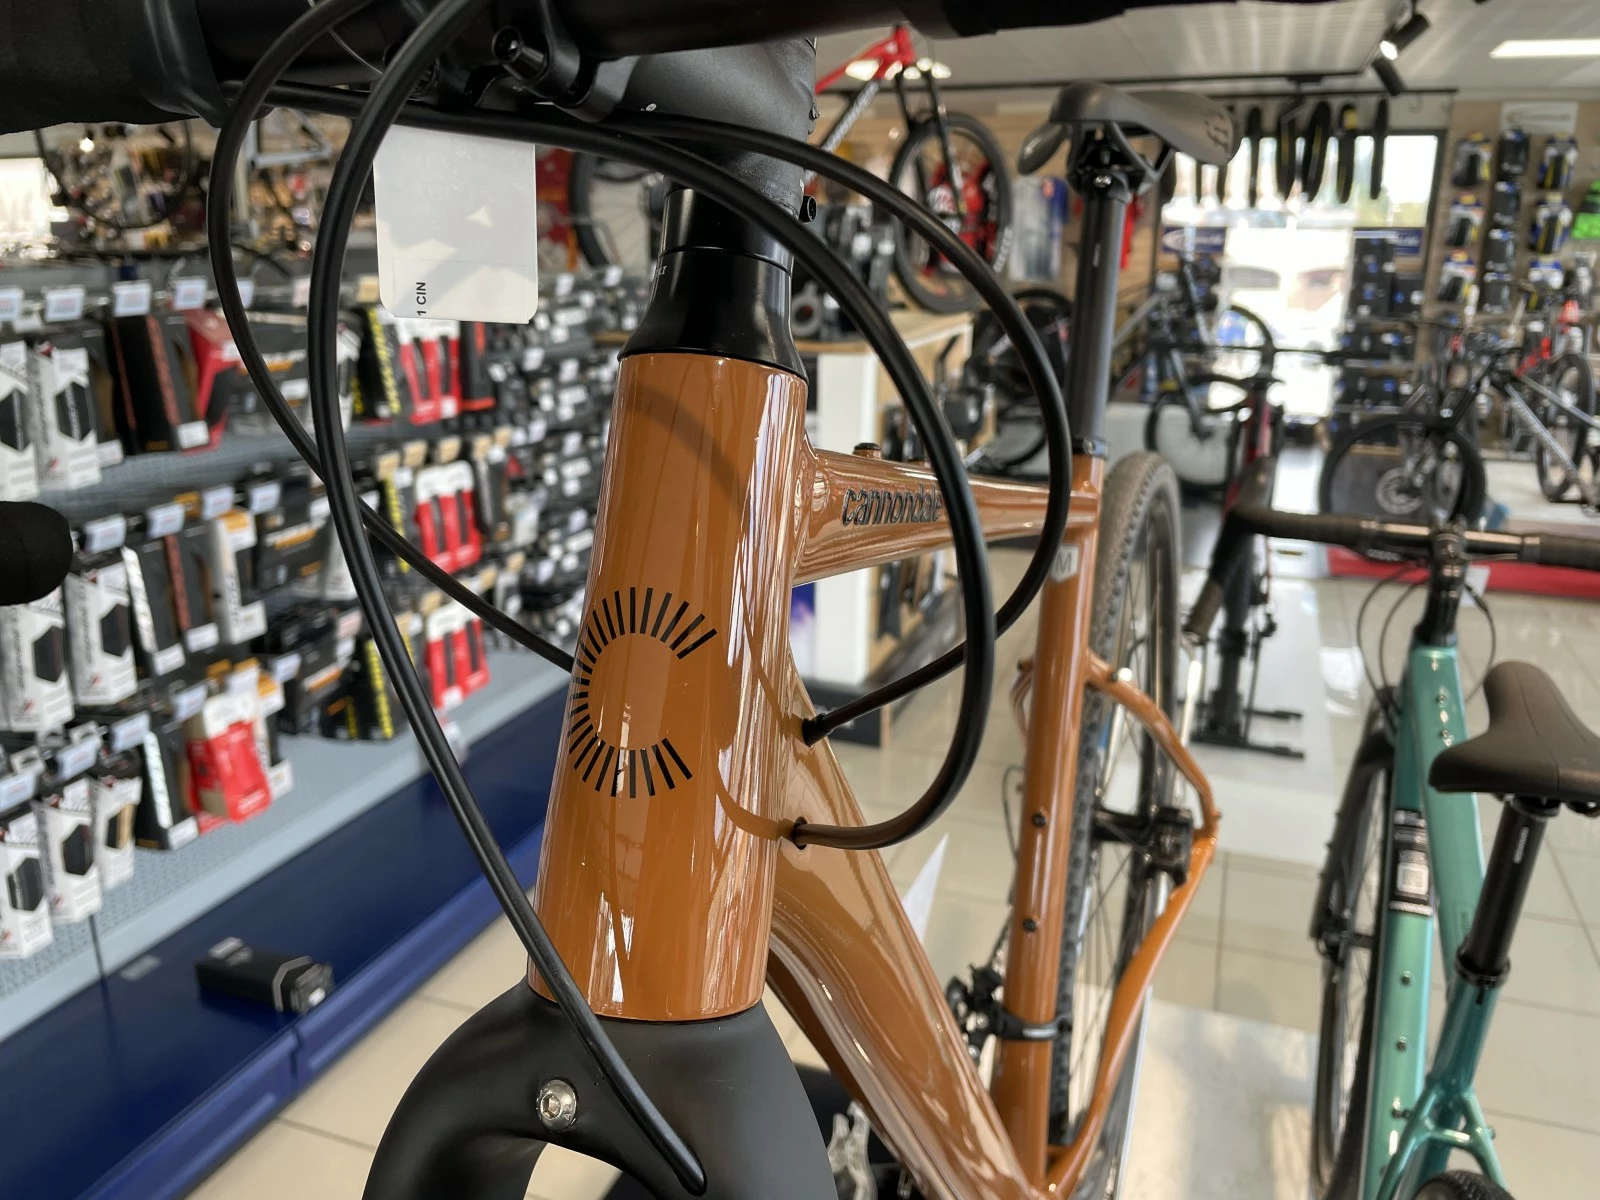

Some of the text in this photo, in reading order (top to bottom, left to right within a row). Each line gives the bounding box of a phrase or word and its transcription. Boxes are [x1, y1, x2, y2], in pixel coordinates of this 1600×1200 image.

[415, 281, 427, 305] CIN
[842, 483, 943, 527] cannondale
[1055, 551, 1072, 574] M
